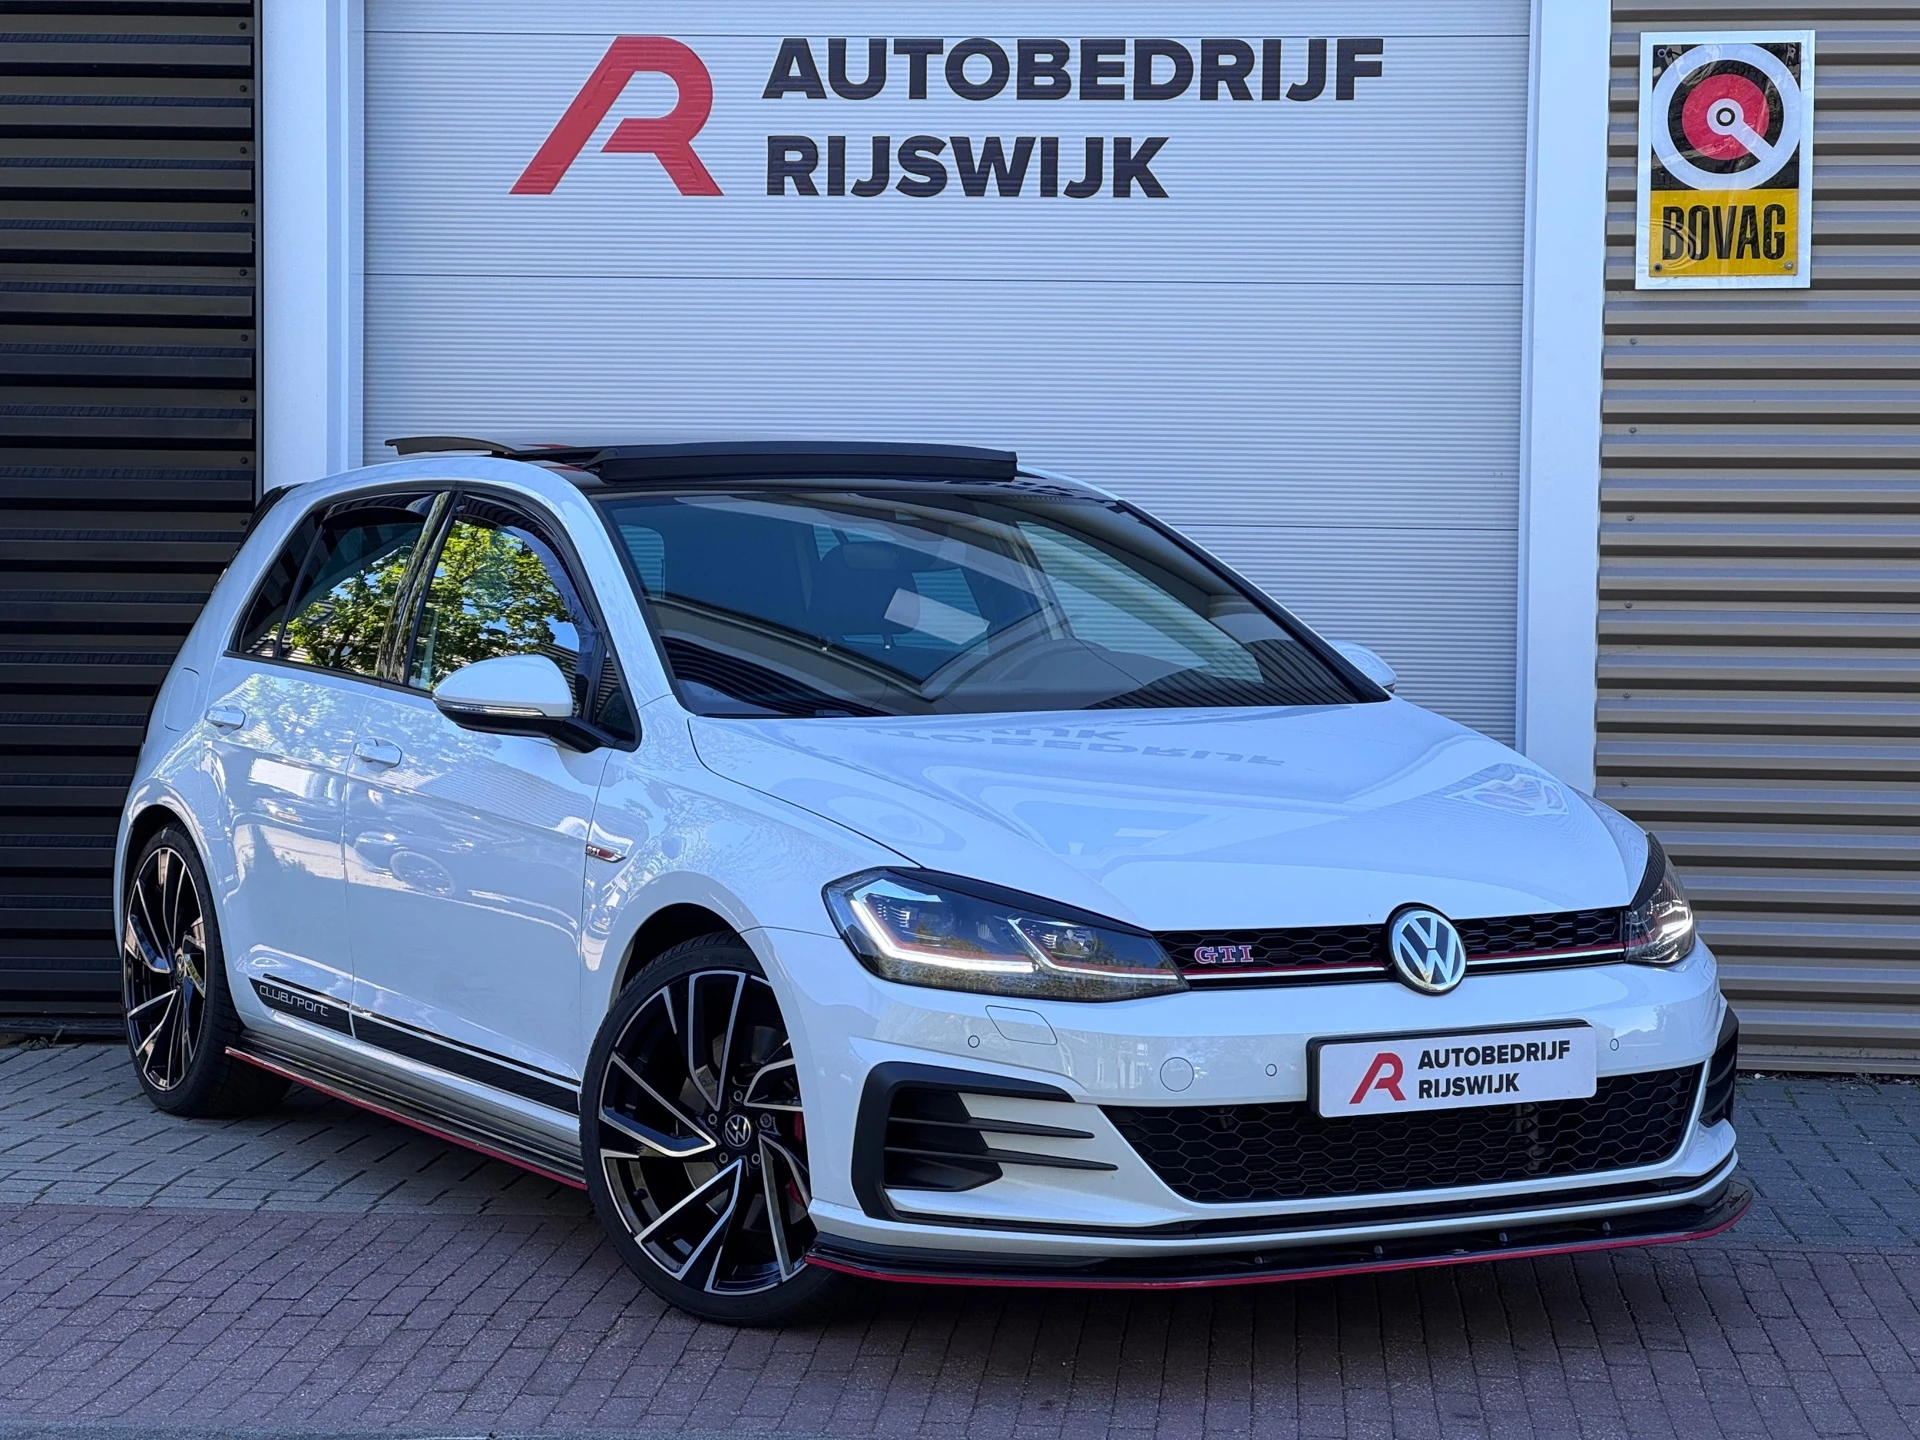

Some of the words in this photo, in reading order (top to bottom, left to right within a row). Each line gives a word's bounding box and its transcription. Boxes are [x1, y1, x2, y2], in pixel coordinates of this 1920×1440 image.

[763, 37, 1384, 101] AUTOBEDRIJF
[766, 135, 1171, 199] RIJSWIJK
[1662, 203, 1786, 260] BOVAG
[1194, 945, 1254, 964] GTI
[1417, 1040, 1571, 1070] AUTOBEDRIJF
[1418, 1073, 1520, 1099] RIJSWIJK
